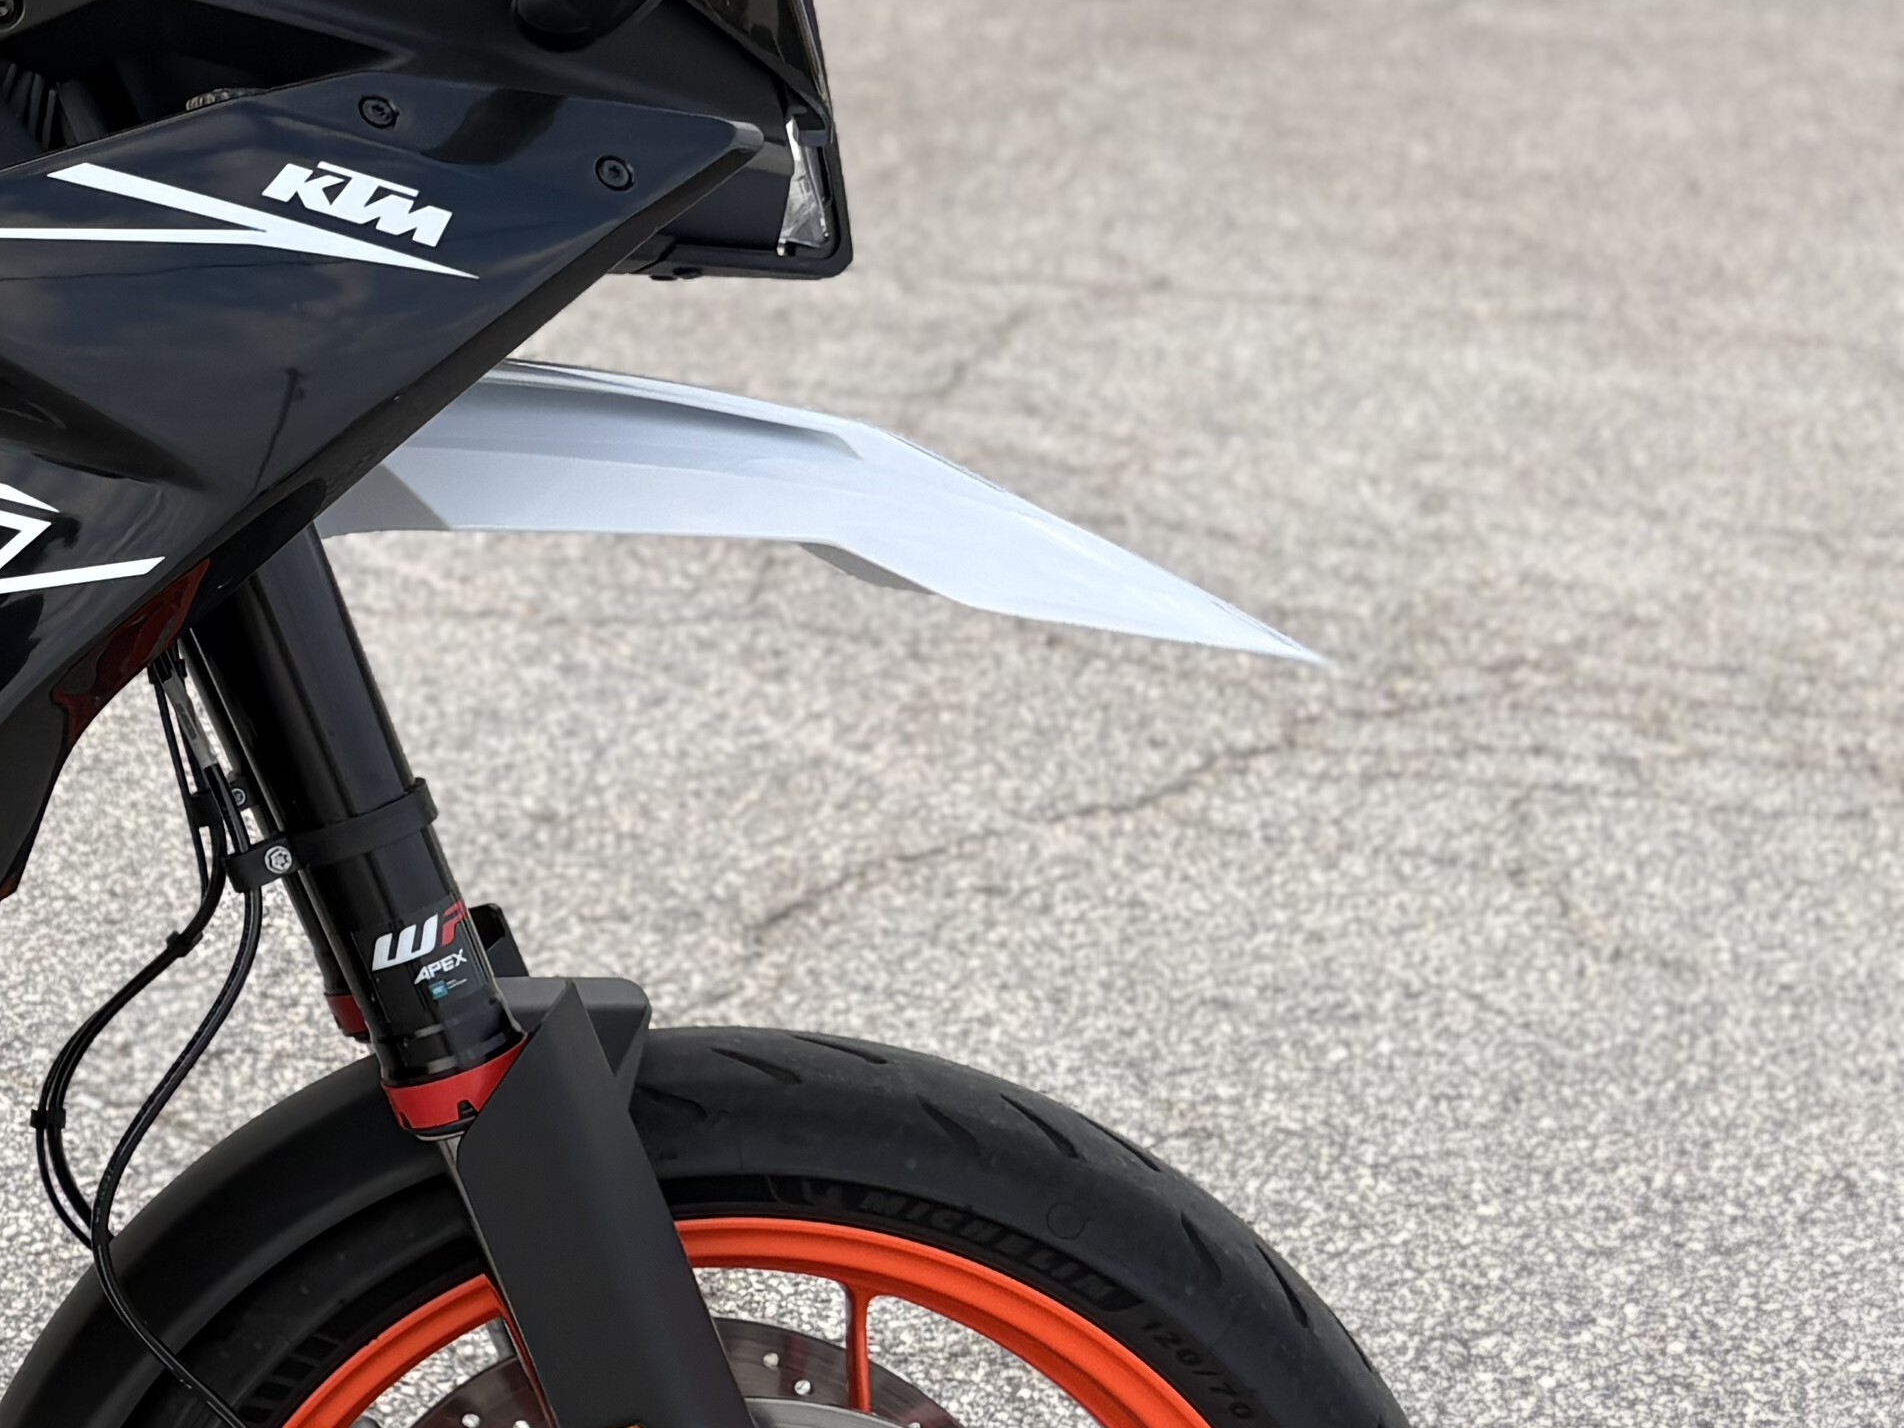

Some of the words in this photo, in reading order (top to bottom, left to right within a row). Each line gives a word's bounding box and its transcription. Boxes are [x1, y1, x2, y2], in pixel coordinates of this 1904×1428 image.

[261, 160, 453, 248] KTM
[413, 948, 468, 985] APEX
[861, 1189, 1124, 1303] MICHELIN
[1137, 1318, 1252, 1425] 120/70
